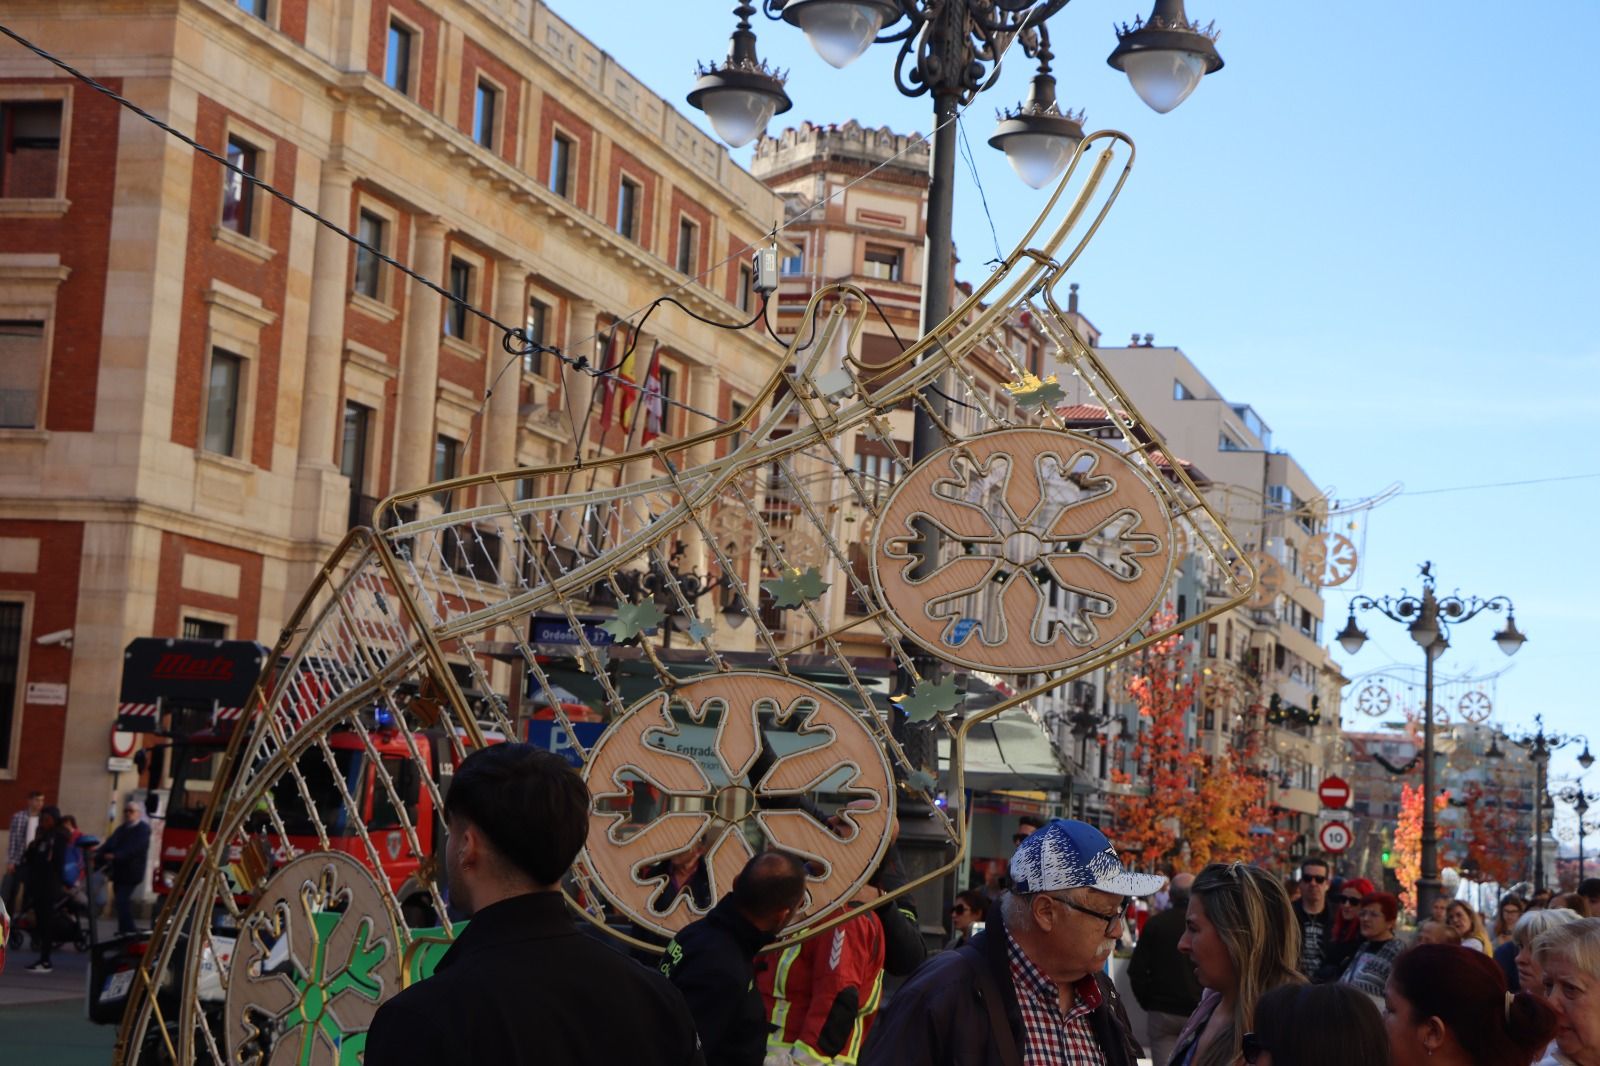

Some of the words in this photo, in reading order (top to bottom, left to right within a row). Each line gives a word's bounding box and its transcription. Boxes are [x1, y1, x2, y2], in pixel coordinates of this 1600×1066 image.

[153, 653, 236, 676] Metz
[549, 725, 571, 754] P
[1329, 832, 1344, 843] 10
